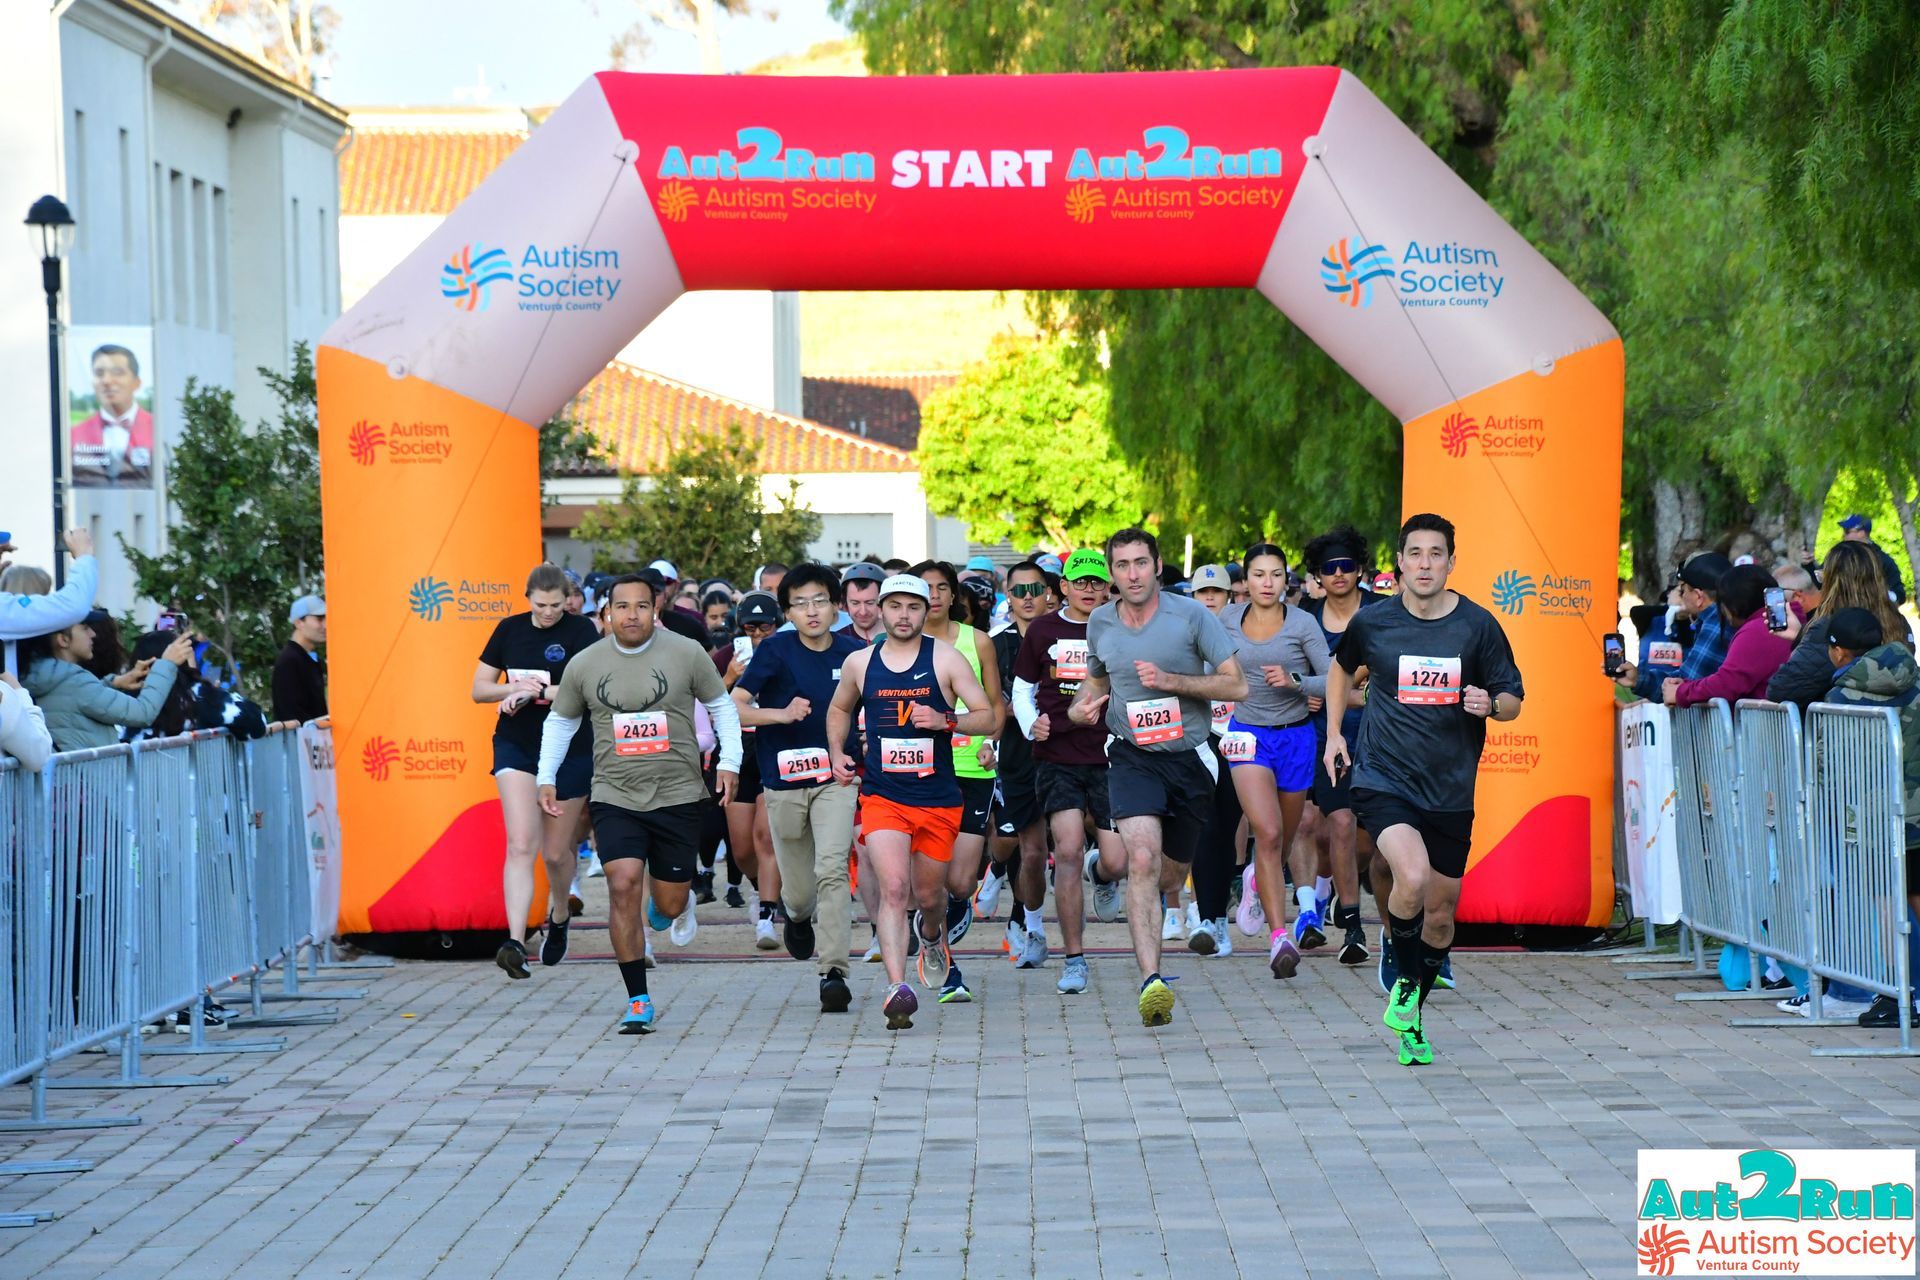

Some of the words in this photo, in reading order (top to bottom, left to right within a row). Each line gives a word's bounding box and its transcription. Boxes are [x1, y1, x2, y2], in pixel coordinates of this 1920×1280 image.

[657, 126, 875, 183] Aut2Run
[1065, 125, 1282, 182] Aut2Run
[891, 149, 1053, 189] START
[704, 187, 785, 210] Autism
[792, 187, 877, 212] Society
[1112, 187, 1191, 208] Autism
[1198, 185, 1284, 209] Society
[704, 210, 747, 219] Ventura
[750, 210, 788, 222] County
[1111, 209, 1154, 219] Ventura
[1156, 208, 1194, 220] County
[522, 245, 619, 269] Autism
[1402, 241, 1498, 267] Autism
[518, 274, 621, 301] Society
[1400, 270, 1504, 298] Society
[518, 302, 562, 312] Ventura
[566, 302, 602, 312] County
[1400, 298, 1446, 308] Ventura
[1450, 297, 1489, 309] County
[390, 421, 450, 437] Autism
[1484, 415, 1544, 431] Autism
[389, 440, 452, 458] Society
[1481, 433, 1546, 452] Society
[1071, 557, 1105, 569] SRIXON
[459, 580, 510, 595] Autism
[1541, 574, 1592, 592] Autism
[457, 597, 513, 615] Society
[1539, 592, 1593, 612] Society
[1654, 649, 1677, 660] 2553
[1411, 670, 1450, 688] 1274
[876, 686, 931, 698] VENTURACERS
[1135, 709, 1172, 729] 2623
[623, 723, 658, 740] 2423
[405, 738, 465, 753] Autism
[1223, 742, 1247, 755] 1414
[404, 756, 468, 774] Society
[787, 756, 821, 774] 2519
[890, 750, 924, 765] 2536
[1479, 749, 1541, 769] Society
